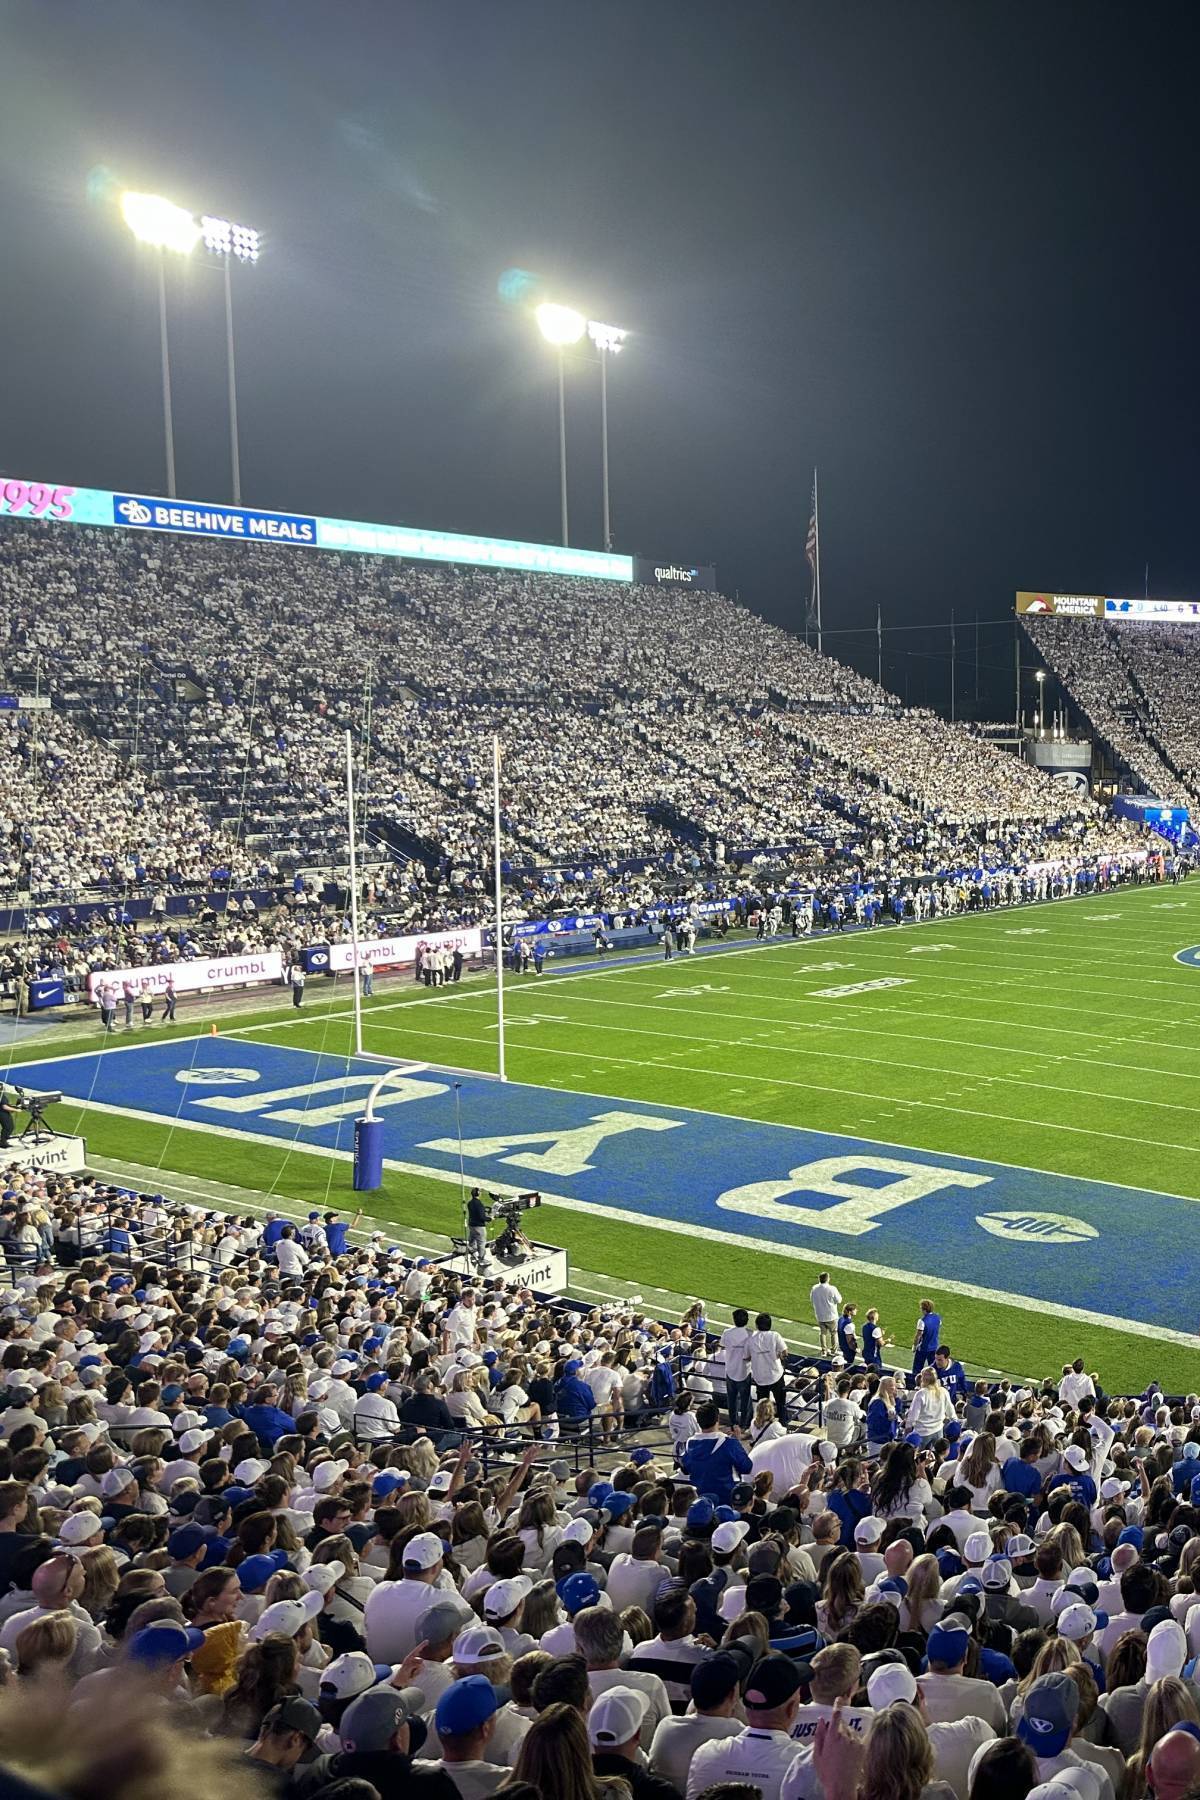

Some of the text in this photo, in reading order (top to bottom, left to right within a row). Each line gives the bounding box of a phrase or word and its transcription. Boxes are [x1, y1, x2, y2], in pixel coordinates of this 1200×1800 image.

[155, 507, 313, 541] BEEHIVE MEALS
[654, 565, 692, 582] qualtrics
[1053, 596, 1098, 607] MOUNTAIN
[1055, 605, 1096, 615] AMERICA
[673, 901, 731, 916] COGARS
[207, 961, 266, 979] crumbl
